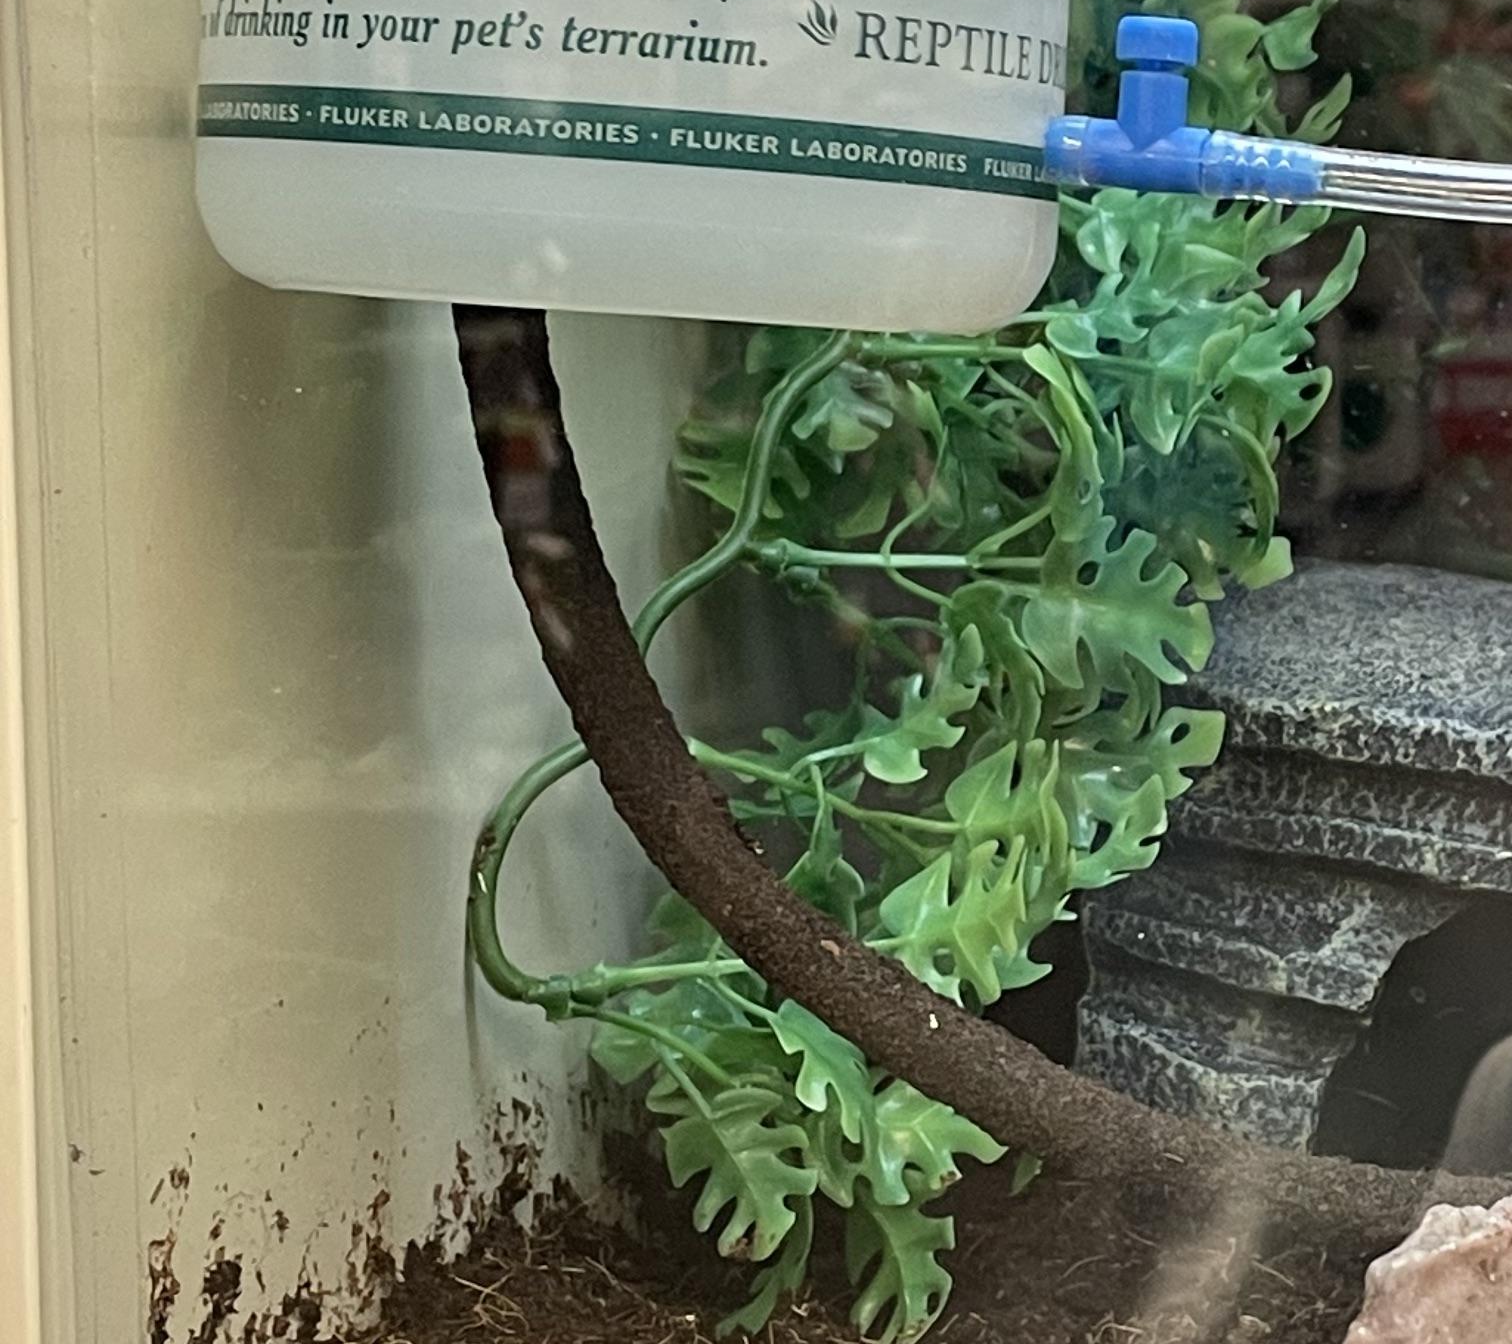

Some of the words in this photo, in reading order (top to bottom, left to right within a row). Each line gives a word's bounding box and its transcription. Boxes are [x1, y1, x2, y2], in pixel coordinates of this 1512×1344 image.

[356, 13, 440, 49] your
[450, 10, 544, 55] pet's
[561, 16, 768, 67] terrarium.
[854, 10, 1032, 81] REPTILE
[319, 105, 409, 129] FLUKER
[418, 111, 640, 144] LABORATORIES
[670, 128, 779, 155] FLUKER
[790, 137, 968, 174] LABORATORIES
[983, 158, 1032, 181] FLUKER
